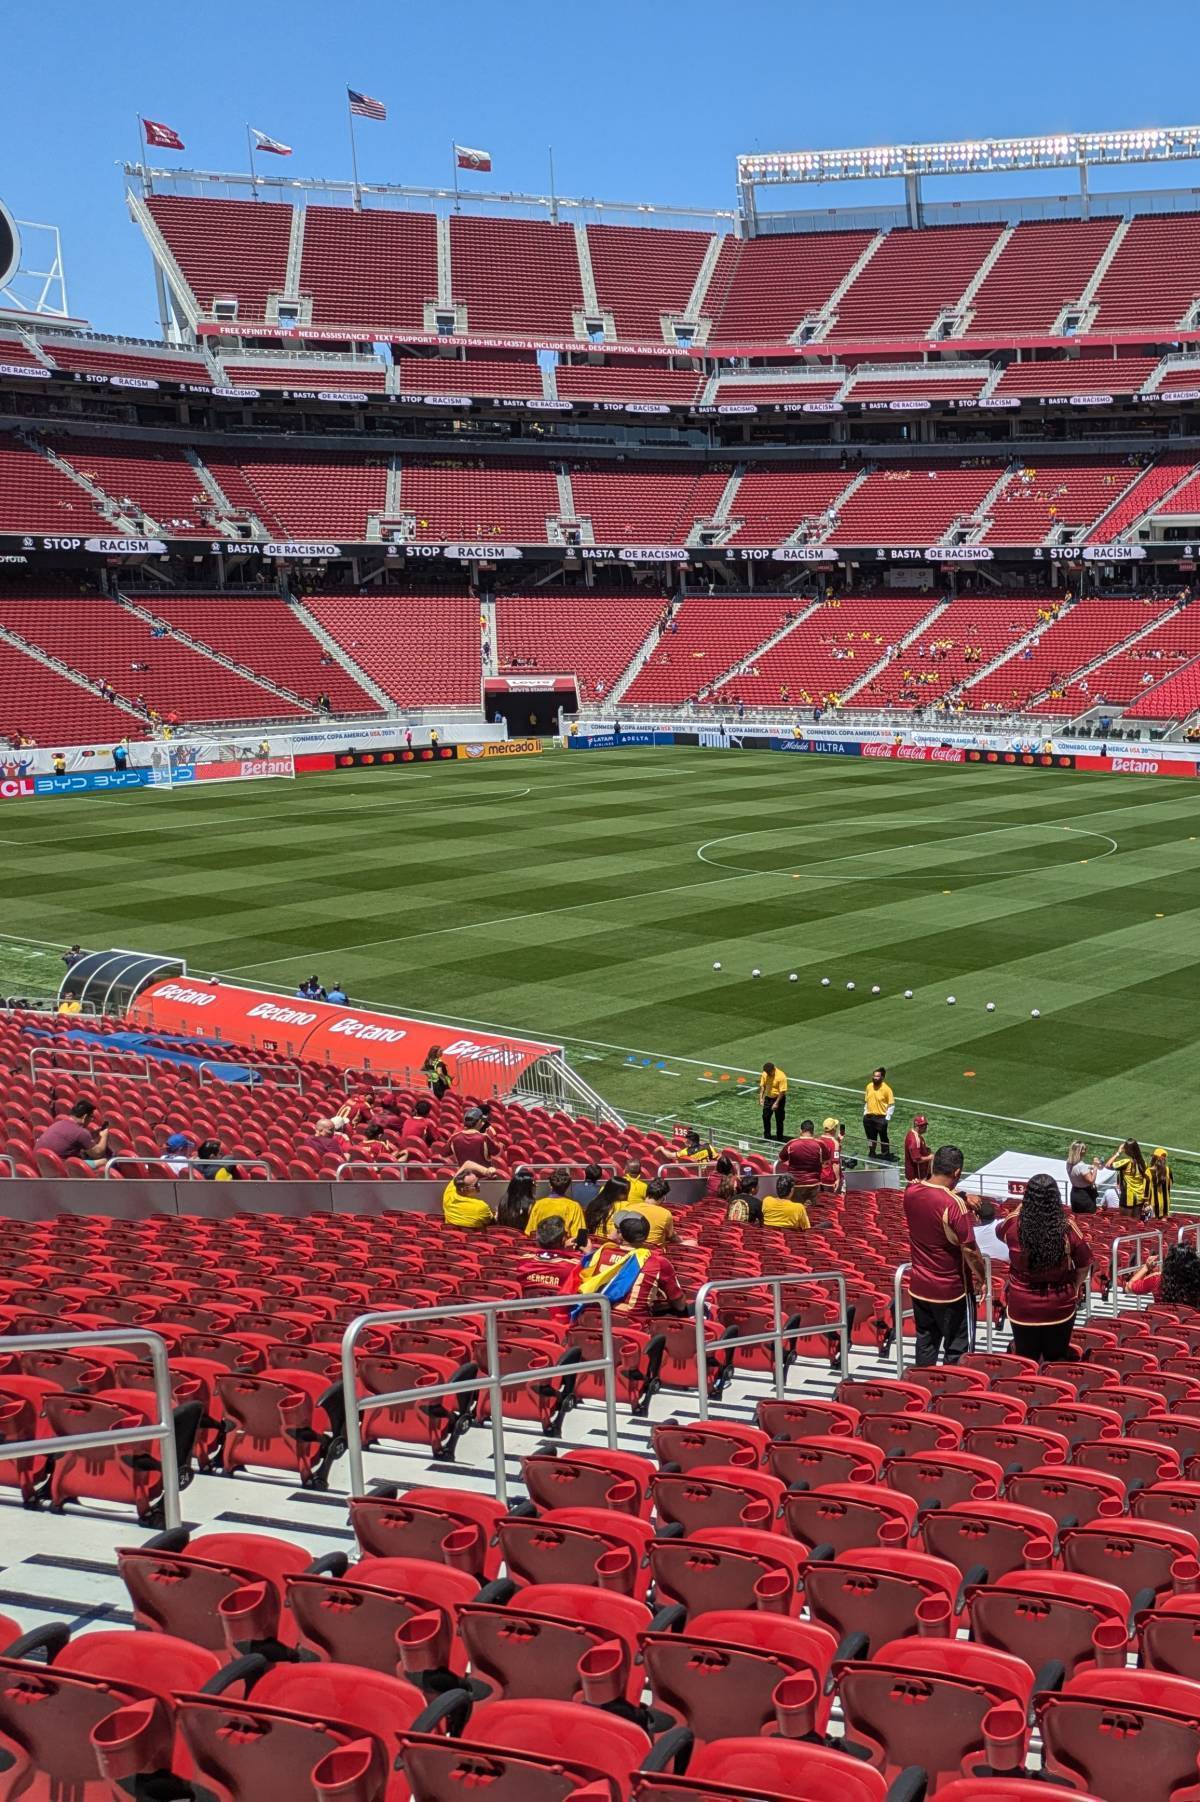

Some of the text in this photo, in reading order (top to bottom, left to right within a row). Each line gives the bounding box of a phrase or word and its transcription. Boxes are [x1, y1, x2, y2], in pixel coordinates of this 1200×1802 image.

[395, 335, 436, 343] "SUPPORT"
[589, 345, 636, 353] DESCRIPTION,
[653, 347, 689, 355] LOCATION.
[14, 367, 48, 377] RACISMO
[86, 374, 149, 387] STOP RACISM
[190, 385, 210, 394] BASTA
[227, 389, 257, 397] RACISMO
[293, 391, 315, 399] BASTA
[335, 393, 365, 401] RACISMO
[44, 539, 149, 551] STOP RACISM
[228, 545, 335, 555] BASTA DE RACISMO
[406, 547, 505, 557] STOP RACISM
[582, 549, 685, 559] BASTA DE RACISMO
[741, 550, 823, 559] STOP RACISM
[891, 550, 988, 558] BASTA DE RACISMO
[1050, 548, 1132, 558] STOP RACISM
[698, 734, 730, 748] PUMA
[816, 740, 845, 752] ULTRA
[488, 741, 534, 756] mercado
[863, 745, 892, 757] Coca-Cola
[897, 747, 927, 759] Coca-Cola
[931, 749, 961, 762] Coca-Cola
[242, 760, 293, 774] Betano
[1111, 758, 1158, 774] Betano
[38, 777, 87, 791] BYD
[94, 774, 140, 788] BYD
[1, 781, 34, 797] CL
[152, 984, 217, 1006] Betano
[246, 1003, 317, 1026] Betano
[329, 1018, 407, 1042] Betano
[443, 1041, 525, 1066] Betano
[675, 1127, 688, 1137] 135
[527, 1273, 560, 1287] HERRERA
